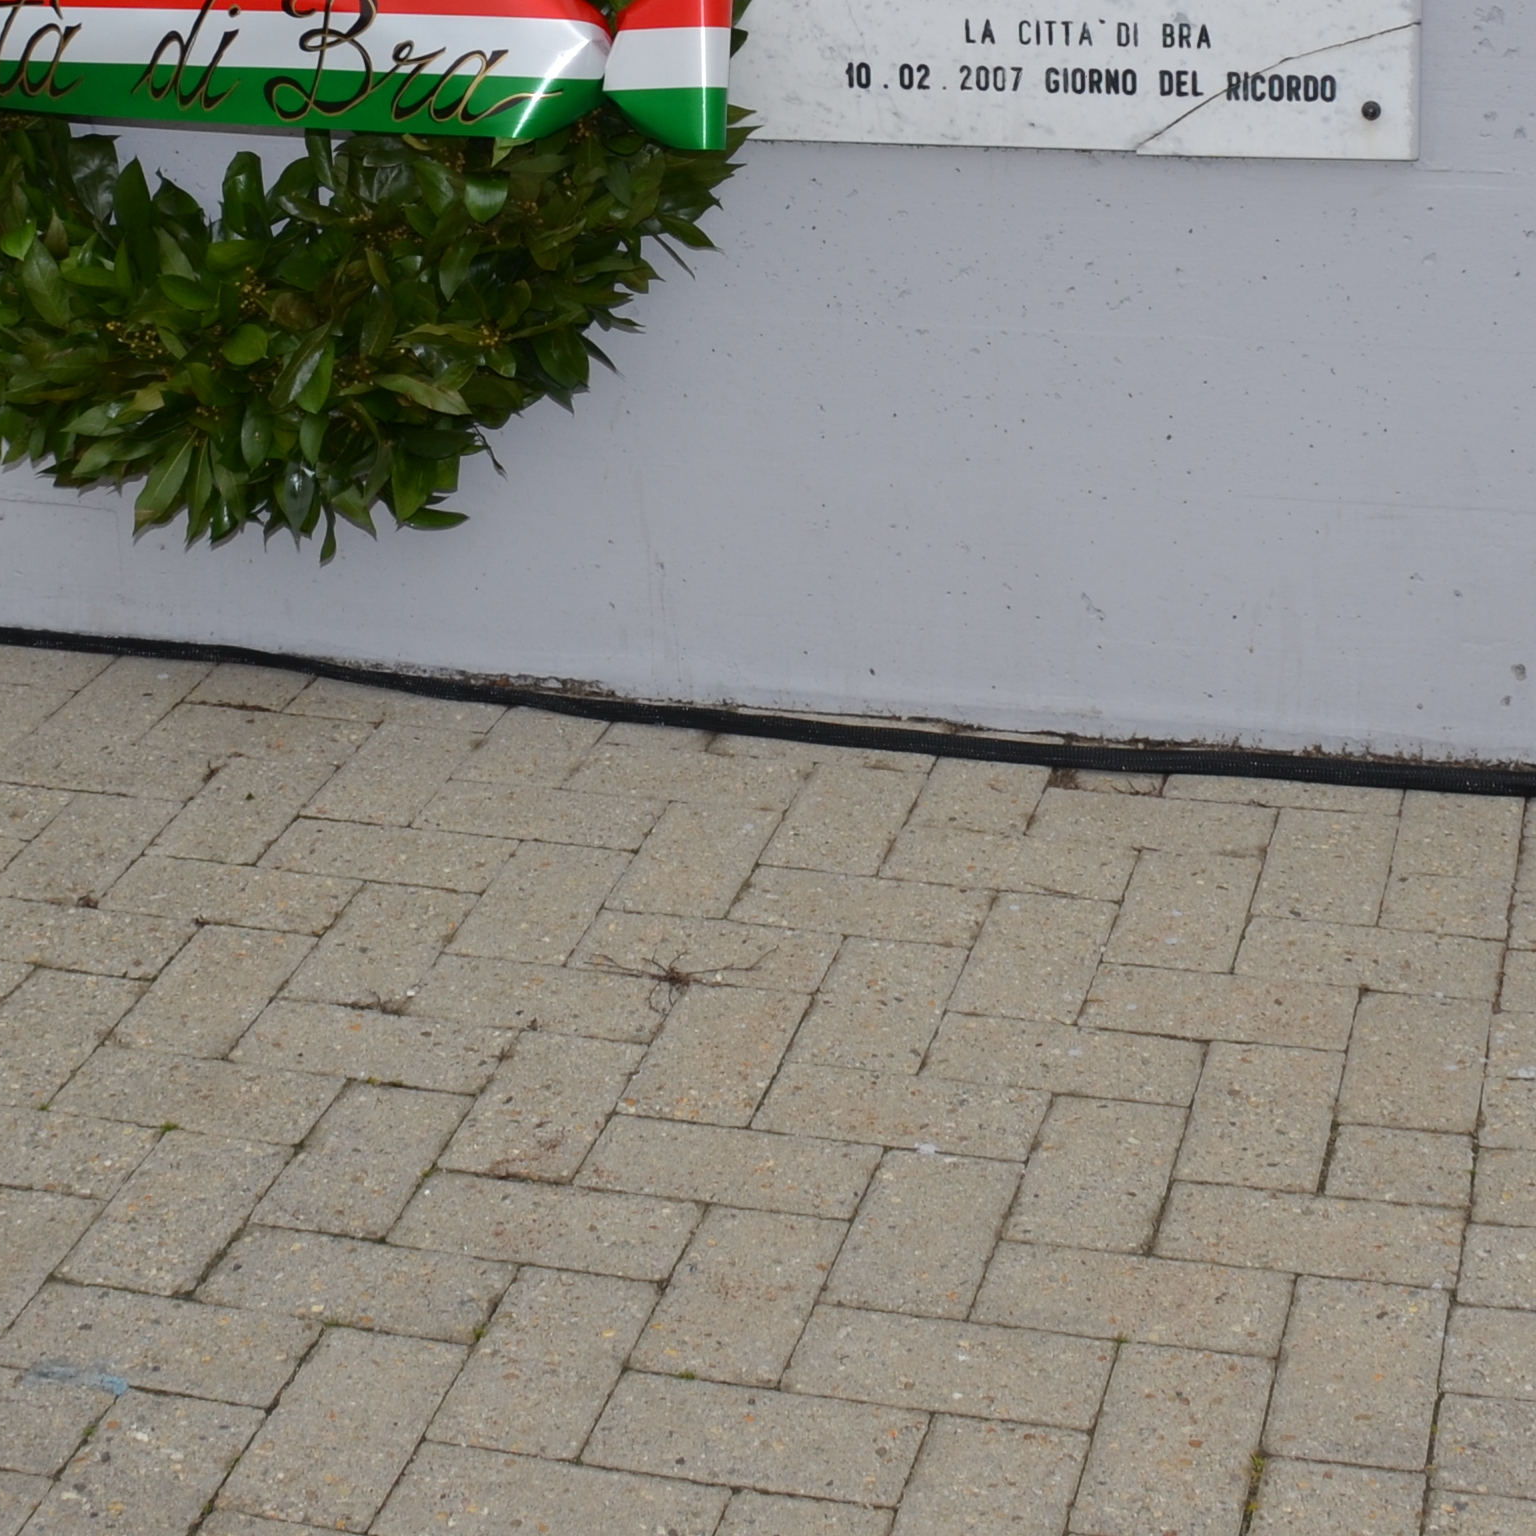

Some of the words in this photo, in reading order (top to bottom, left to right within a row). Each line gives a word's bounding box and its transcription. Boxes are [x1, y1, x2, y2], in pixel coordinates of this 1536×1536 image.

[964, 18, 996, 45] LA
[1116, 21, 1139, 48] DI
[1161, 22, 1212, 49] BRA
[1044, 66, 1138, 97] GIORNO
[1158, 69, 1205, 98] DEL
[1226, 70, 1338, 103] RICORDO
